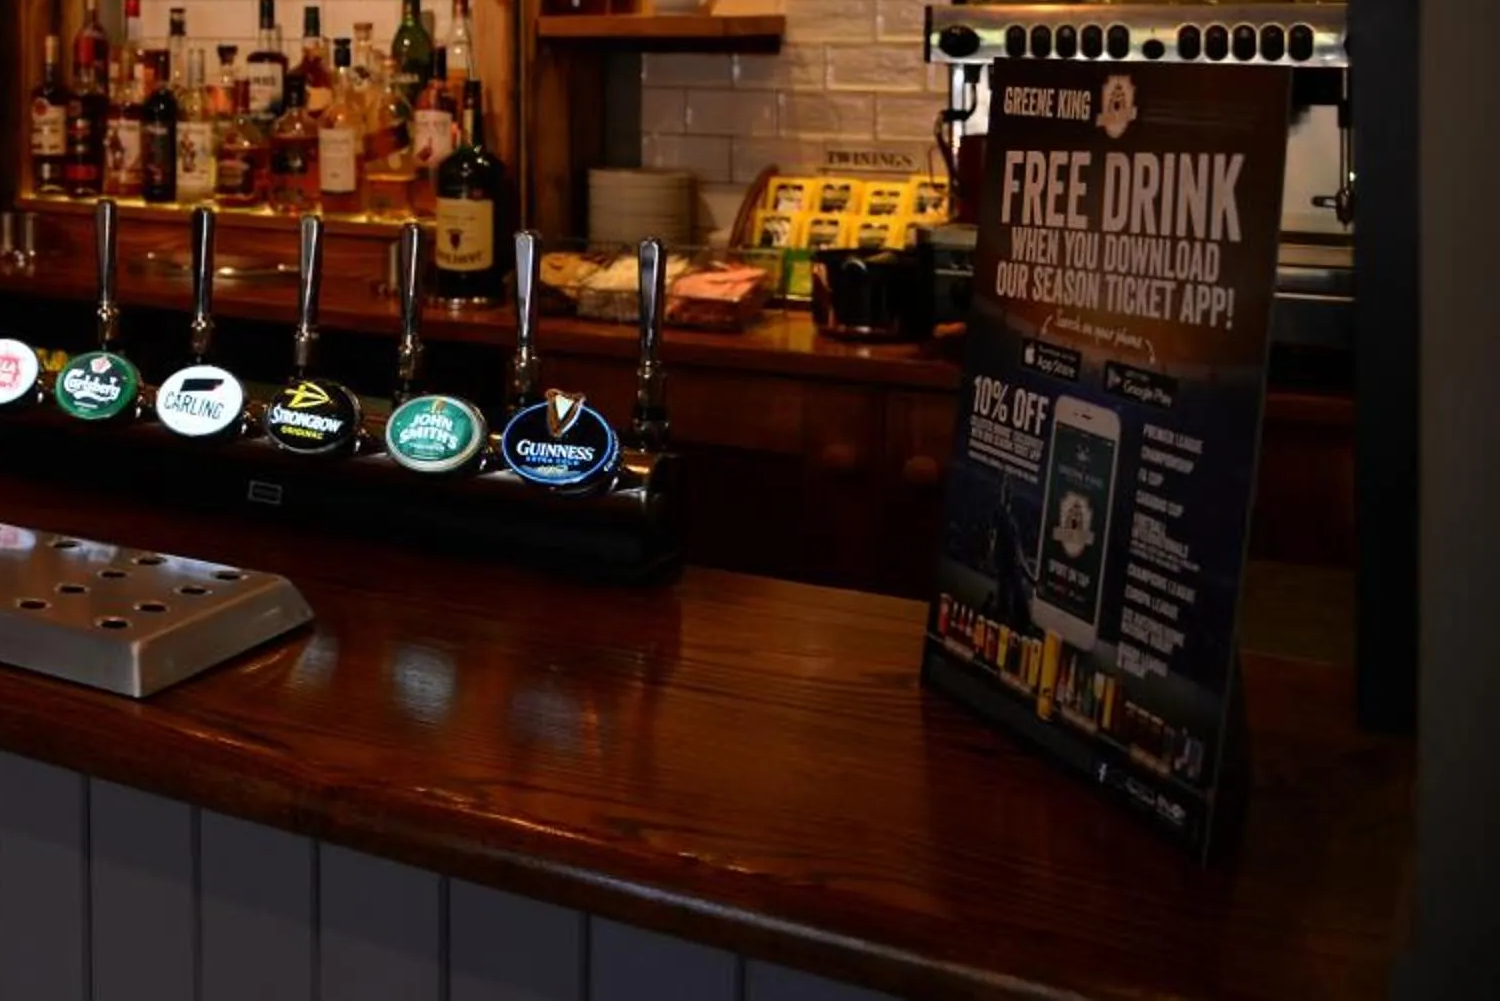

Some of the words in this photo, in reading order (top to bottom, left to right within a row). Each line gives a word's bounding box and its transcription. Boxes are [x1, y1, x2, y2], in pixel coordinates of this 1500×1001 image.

[1003, 85, 1055, 119] GREENE
[1057, 88, 1092, 121] KING
[826, 150, 915, 167] TWININGS
[1001, 150, 1093, 230] FREE
[1102, 151, 1246, 243] DRINK
[1010, 225, 1060, 266] WHEN
[1063, 229, 1100, 271] YOU
[1102, 233, 1221, 284] DOWNLOAD
[995, 259, 1029, 301] OUR
[1031, 265, 1100, 312] SEASON
[1104, 273, 1178, 321] TICKET
[1178, 282, 1236, 331] APP!
[63, 368, 121, 400] Carlsberg
[163, 391, 226, 420] CARLING
[269, 403, 343, 434] STRONGBOW
[973, 374, 1010, 424] 10%
[1012, 386, 1050, 437] OFF
[409, 412, 454, 431] JOHN
[399, 425, 459, 450] SMITH'S
[516, 439, 596, 461] GUINNESS
